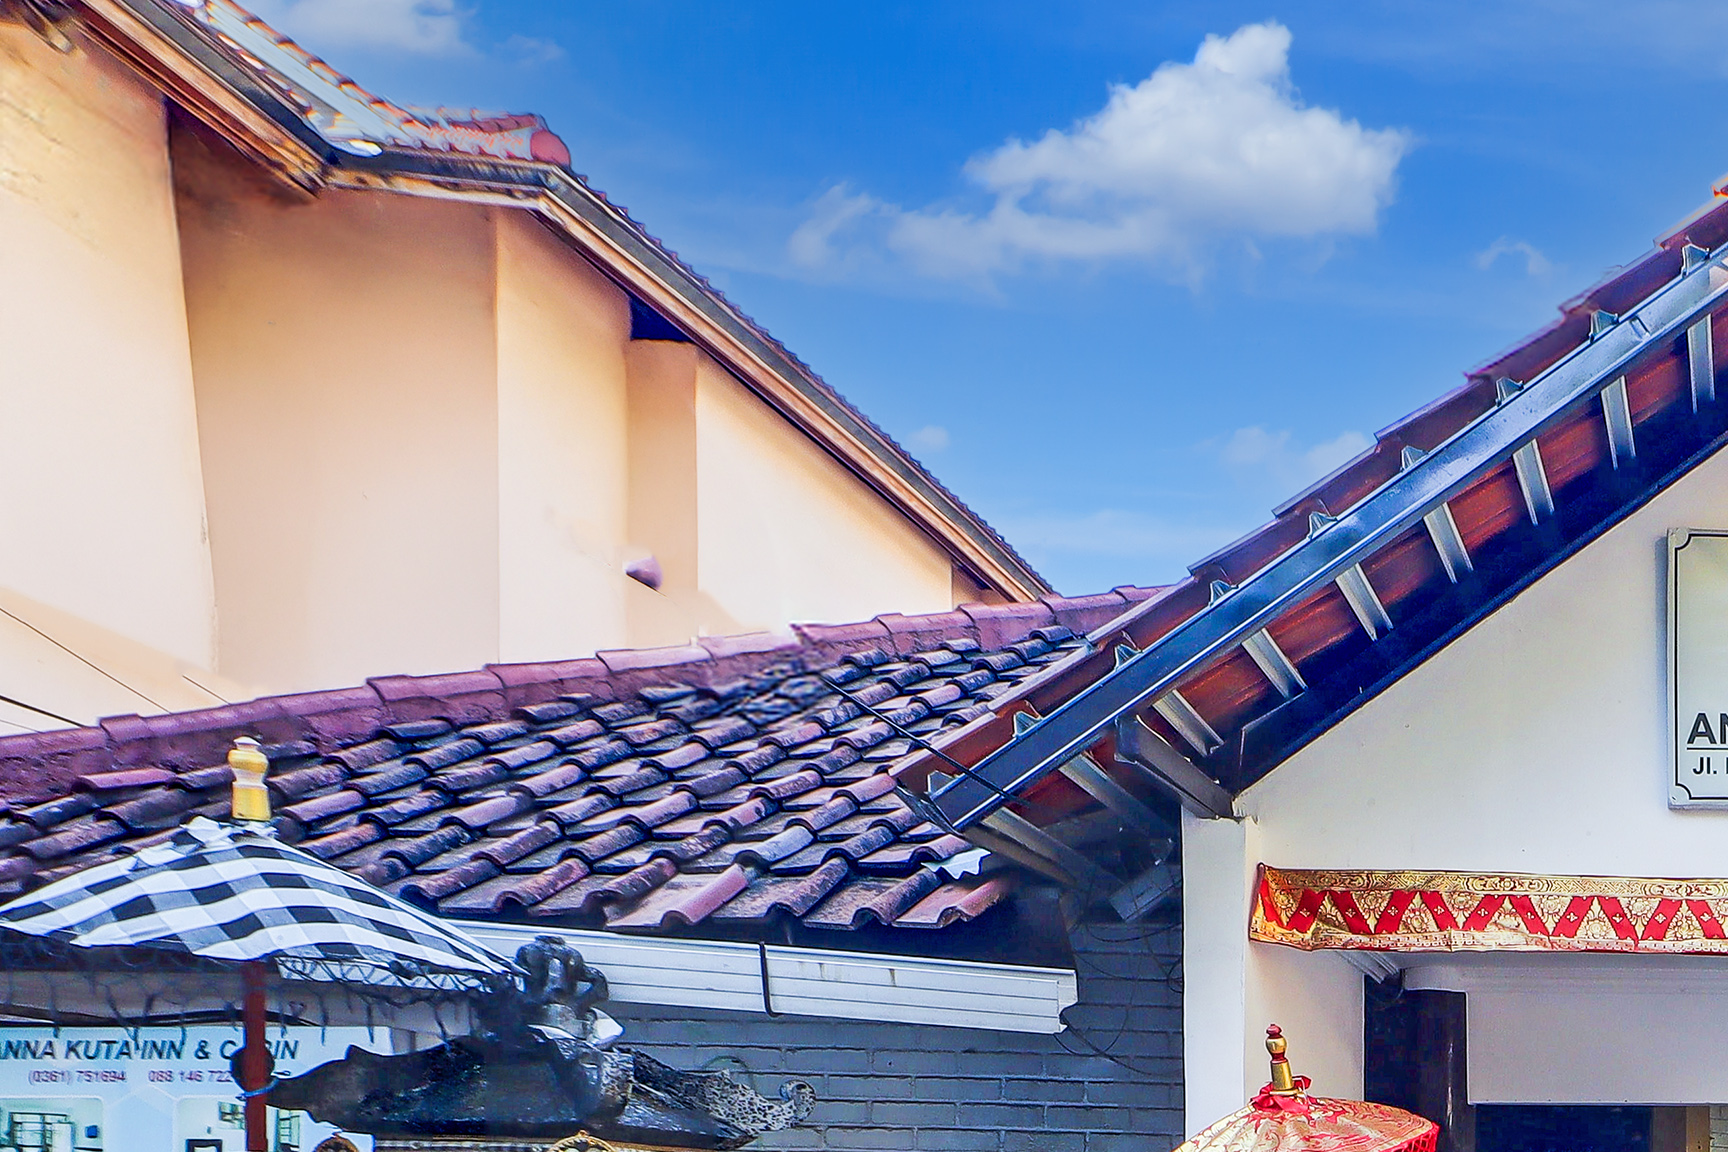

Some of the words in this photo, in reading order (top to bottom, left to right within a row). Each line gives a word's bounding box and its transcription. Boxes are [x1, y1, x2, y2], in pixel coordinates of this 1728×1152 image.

[1692, 756, 1718, 775] Jl.
[0, 1040, 56, 1060] NNA
[64, 1040, 132, 1060] KUTA
[140, 1040, 182, 1060] INN
[194, 1040, 210, 1060] &
[219, 1040, 299, 1061] CIN
